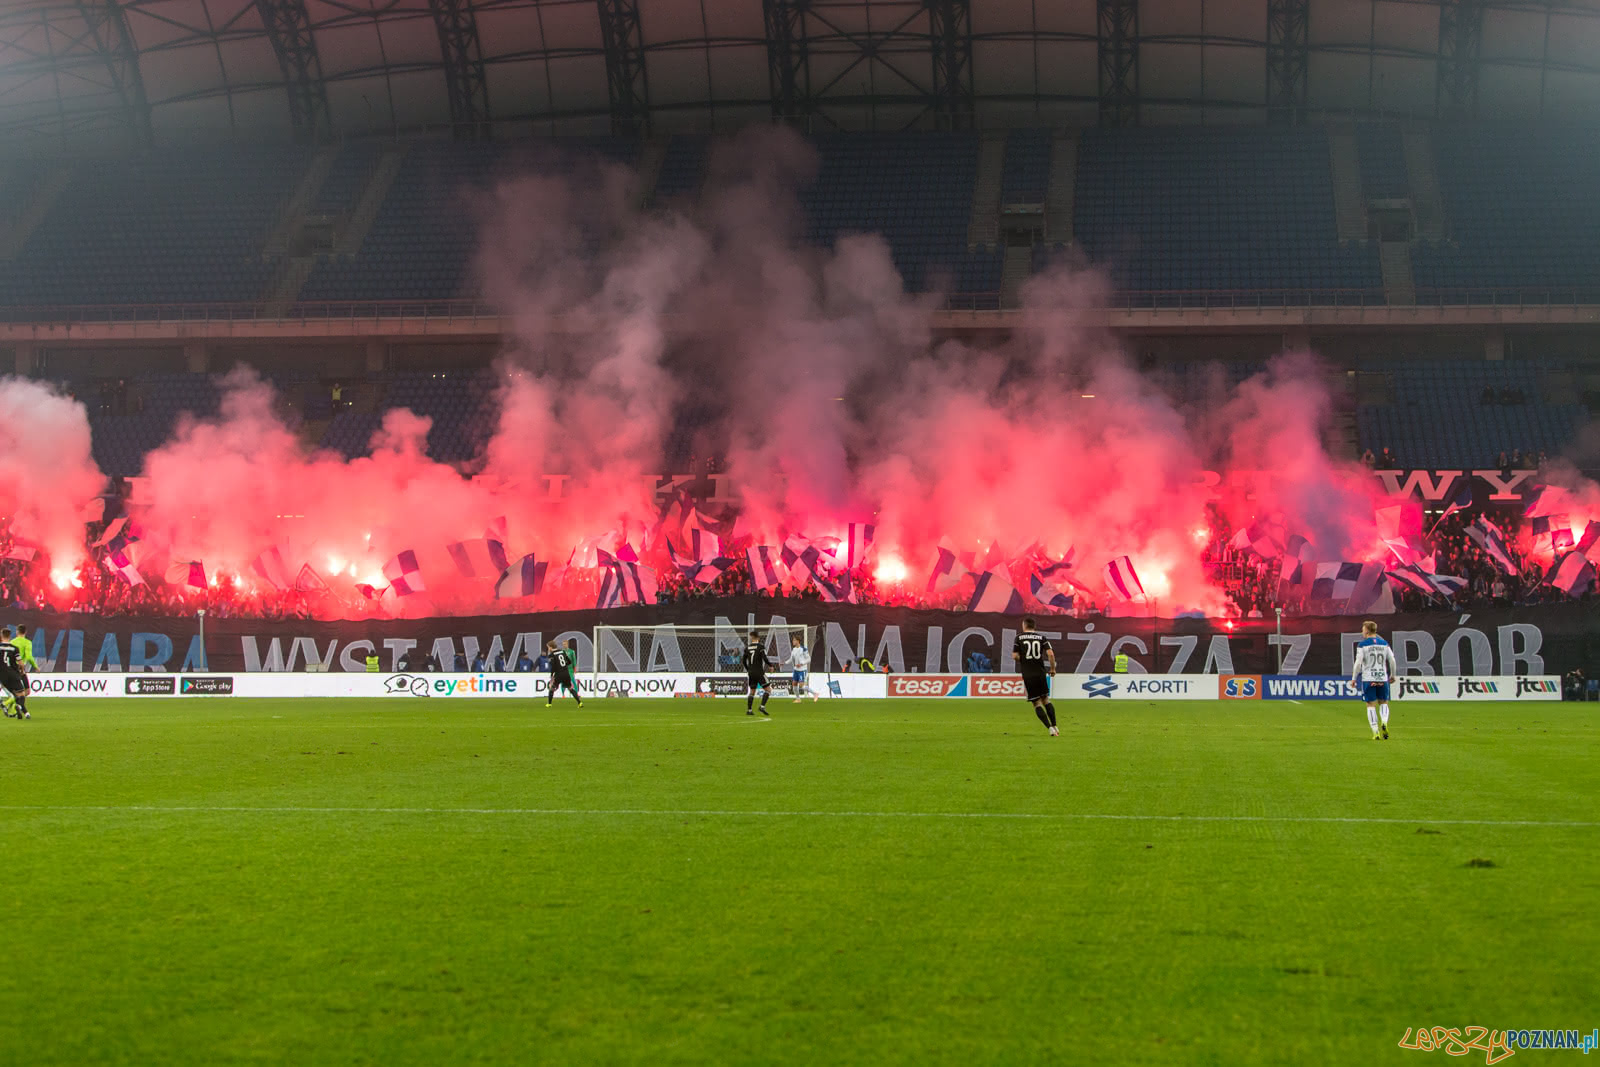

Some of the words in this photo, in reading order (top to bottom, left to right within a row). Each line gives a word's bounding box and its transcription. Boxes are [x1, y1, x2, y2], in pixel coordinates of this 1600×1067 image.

[749, 650, 756, 664] 7
[1023, 640, 1041, 660] 20
[3, 651, 10, 667] 4
[558, 654, 566, 667] 8
[67, 679, 107, 692] NOW
[434, 674, 517, 696] eyetime
[635, 679, 677, 692] NOW
[893, 678, 943, 694] tesa
[975, 678, 1025, 694] tesa
[1127, 680, 1188, 694] AFORTI
[1225, 678, 1256, 698] STS
[1398, 677, 1426, 699] jtc
[1456, 677, 1484, 699] jtc
[1515, 676, 1543, 698] jtc
